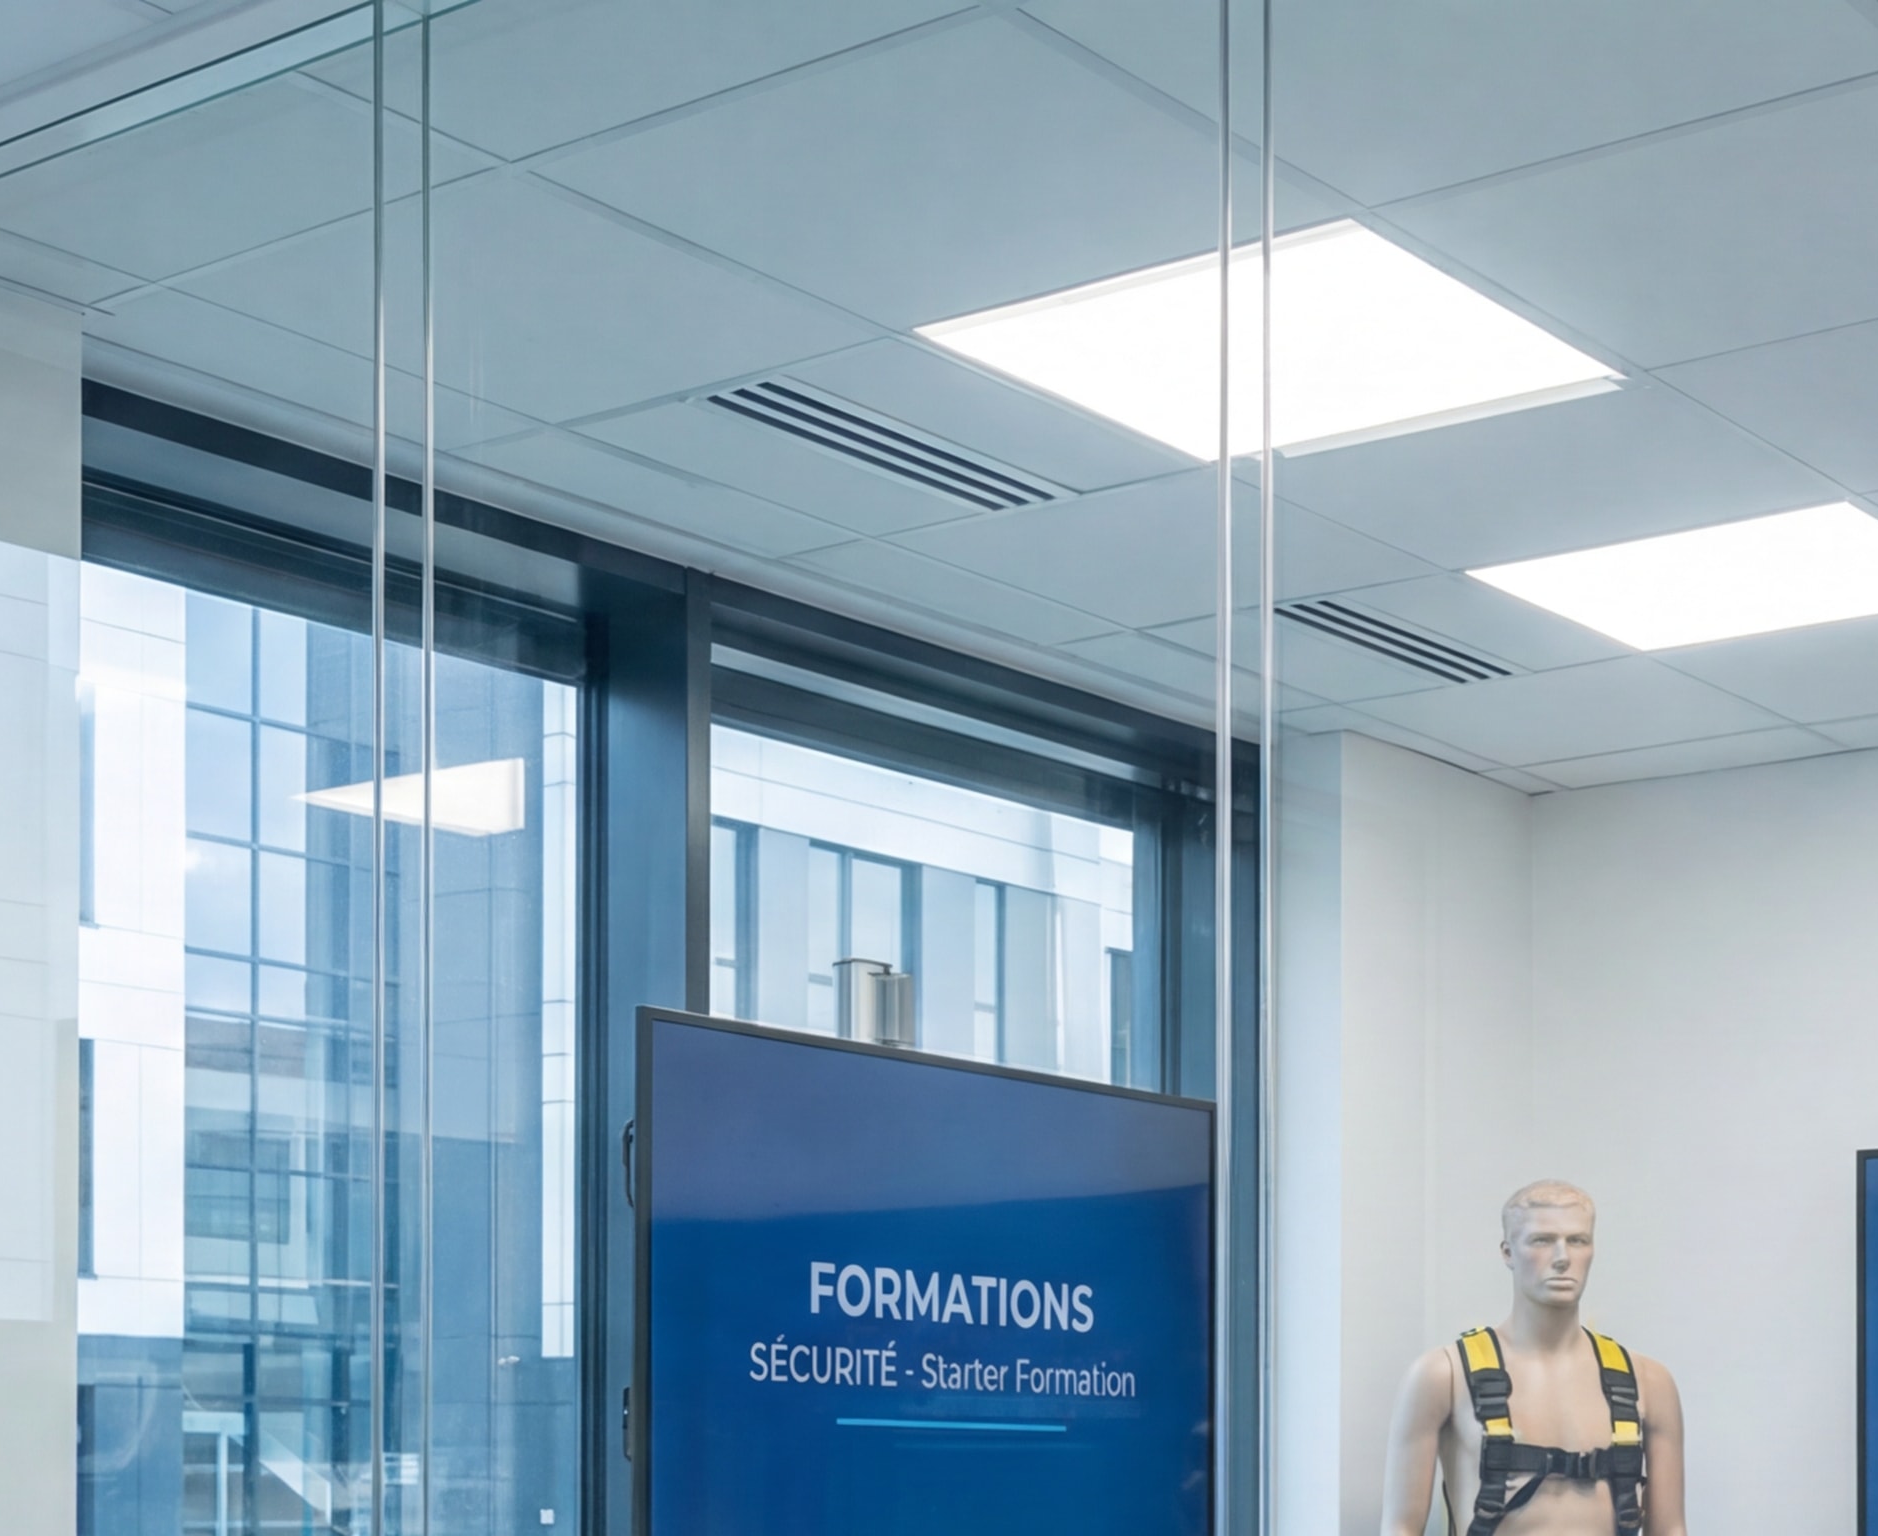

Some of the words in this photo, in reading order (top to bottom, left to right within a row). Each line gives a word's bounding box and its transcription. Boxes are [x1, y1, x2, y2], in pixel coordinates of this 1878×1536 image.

[810, 1261, 1094, 1333] FORMATIONS
[749, 1334, 898, 1387] SÉCURITÉ
[921, 1352, 1009, 1392] Starter
[1015, 1358, 1136, 1397] Formation
